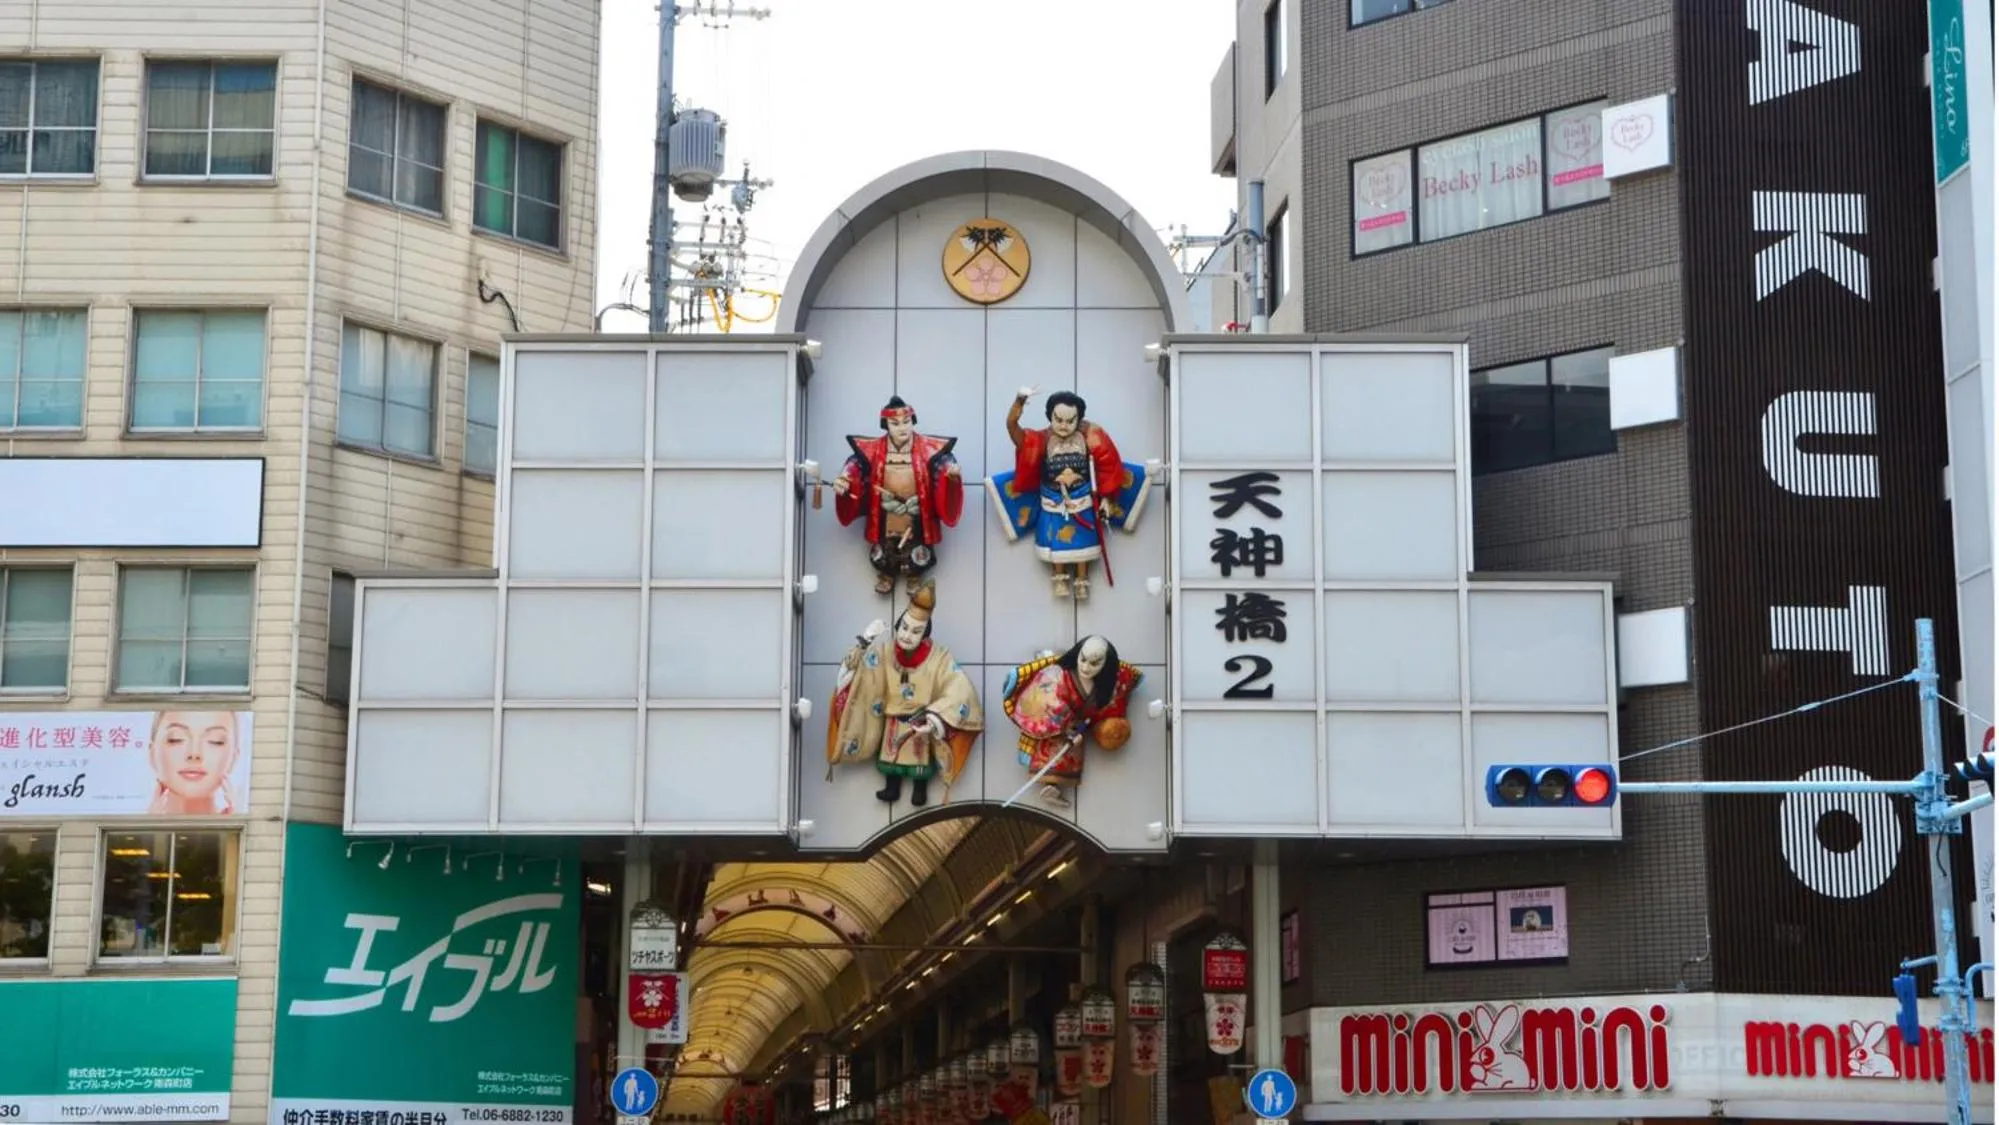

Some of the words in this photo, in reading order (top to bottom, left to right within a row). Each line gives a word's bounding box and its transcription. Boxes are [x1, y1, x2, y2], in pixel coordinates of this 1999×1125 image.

[1423, 170, 1481, 199] Becky
[1490, 154, 1539, 185] Lash
[1209, 472, 1287, 700] 天神橋2
[0, 726, 144, 749] 進化型美容。
[4, 773, 86, 808] glansh
[288, 893, 564, 1023] エイブル
[1340, 1012, 1475, 1094] mini
[1521, 1004, 1671, 1091] mini
[1744, 1021, 1851, 1079] mini
[461, 1108, 564, 1122] Tel.06-6882-1230
